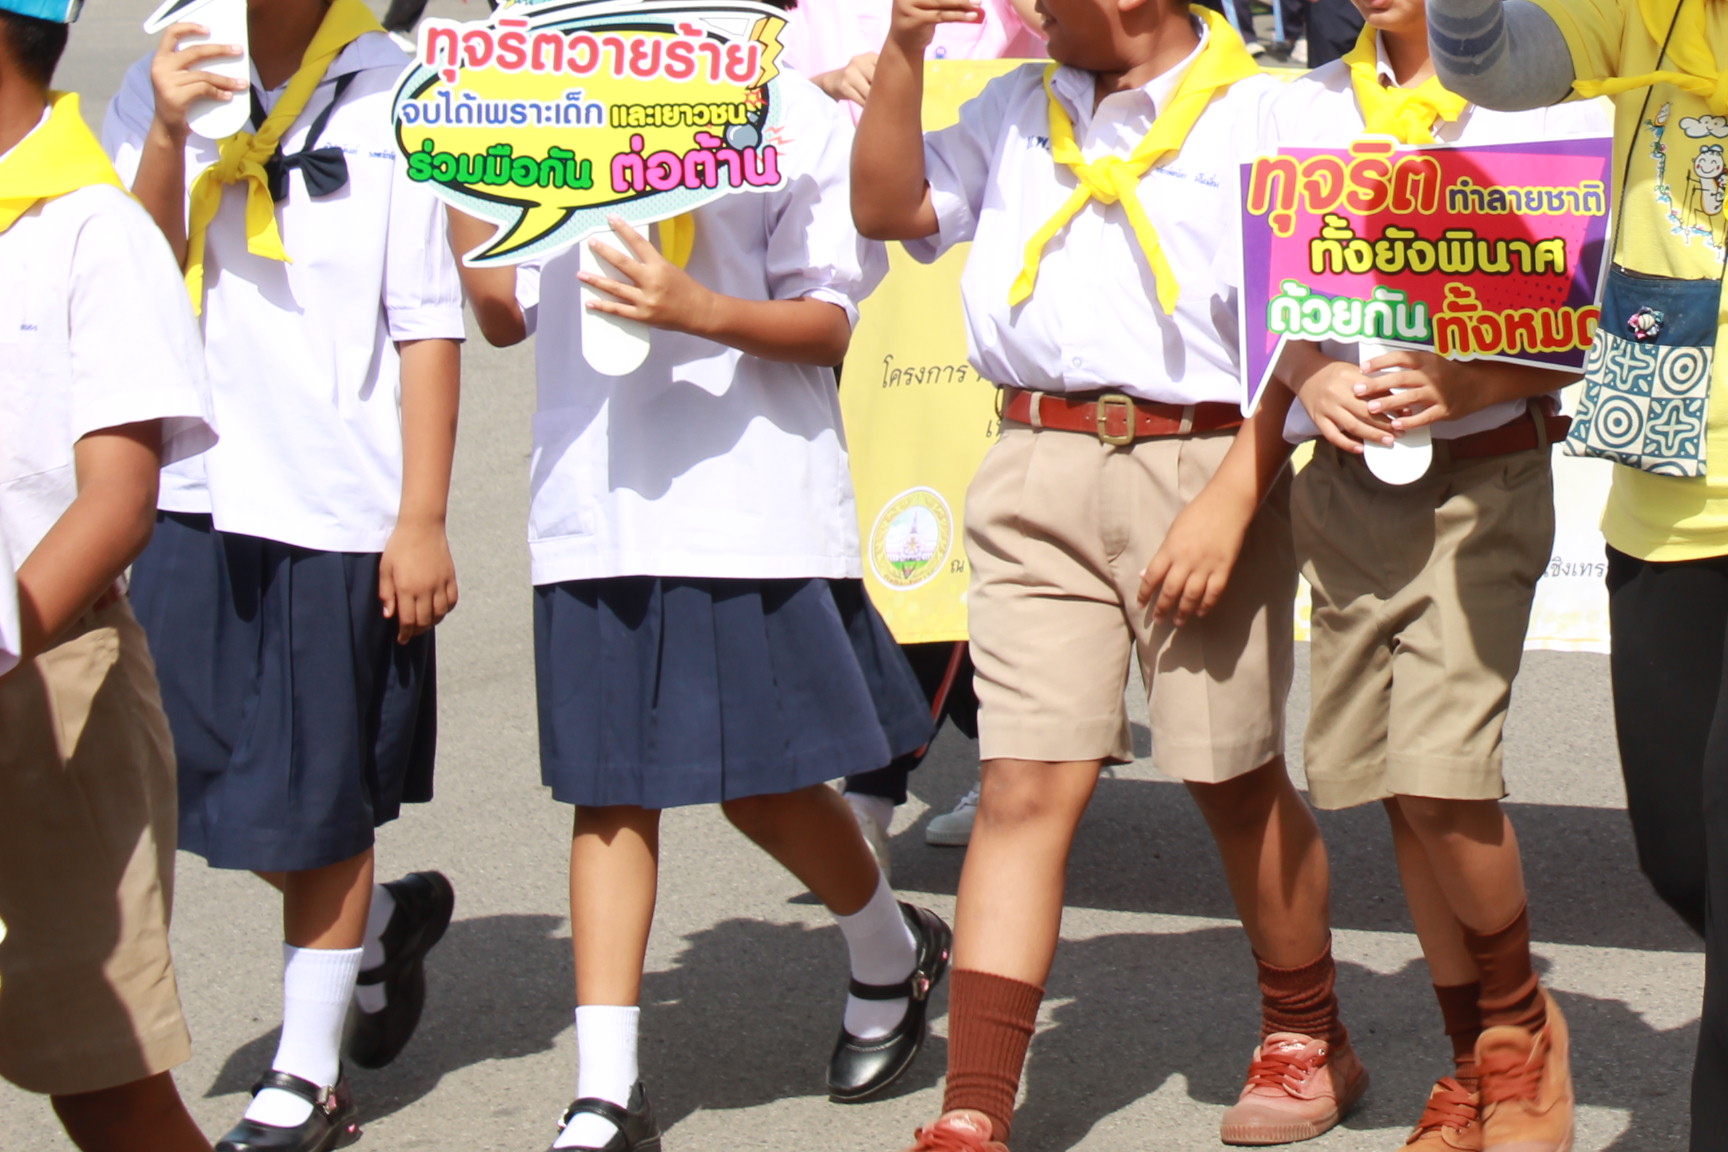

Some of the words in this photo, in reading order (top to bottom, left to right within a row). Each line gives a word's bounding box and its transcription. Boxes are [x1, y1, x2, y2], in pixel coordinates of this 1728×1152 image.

[426, 19, 759, 83] ทุจริตวายร้าย
[402, 91, 602, 125] จบได้เพราะเด็ก
[610, 103, 748, 128] และเยาวชน
[407, 139, 593, 189] ร่วมมือกัน
[610, 132, 781, 194] ต่อต้าน
[1247, 139, 1441, 237] ทุจริต
[1447, 176, 1605, 216] ทำลายชาติ
[1309, 214, 1566, 275] ทั้งยังพินาศ
[1267, 280, 1430, 341] ด้วยกัน
[882, 354, 968, 388] โครงการ
[1544, 556, 1605, 578] ชิงเทร
